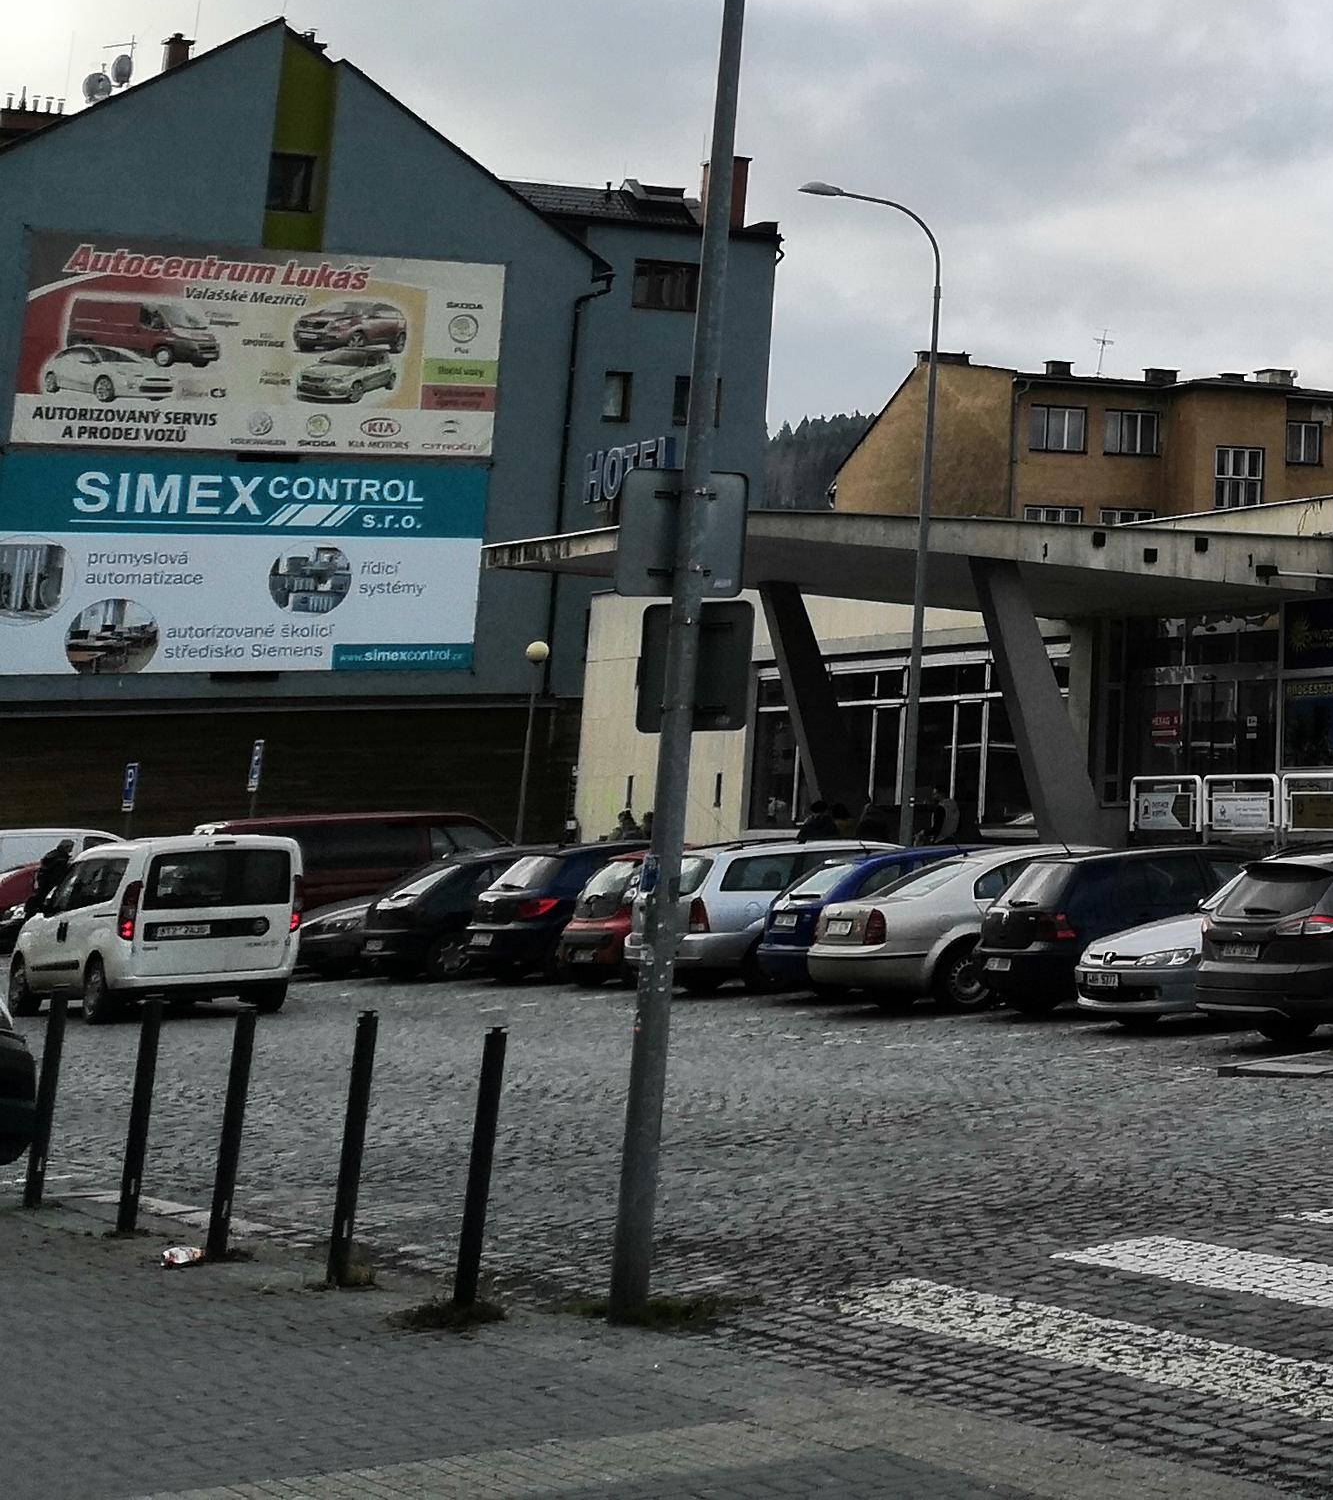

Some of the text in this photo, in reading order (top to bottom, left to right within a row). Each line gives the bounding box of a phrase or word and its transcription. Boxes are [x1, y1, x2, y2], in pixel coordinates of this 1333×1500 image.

[62, 244, 371, 291] Autocentrum Lukáš
[185, 287, 248, 303] Valašské
[32, 405, 218, 426] AUTORIZOVANÝ SERVIS
[61, 424, 187, 443] A PRODEJ VOZŮ
[367, 422, 395, 434] KIA
[73, 471, 424, 517] SIMEX CONTROL
[362, 512, 423, 529] s.r.o.
[87, 549, 189, 569] průmyslová
[85, 570, 204, 587] automatizace
[359, 580, 424, 597] systémy
[166, 622, 275, 640] autorizované
[164, 642, 324, 660] středisko Siemens
